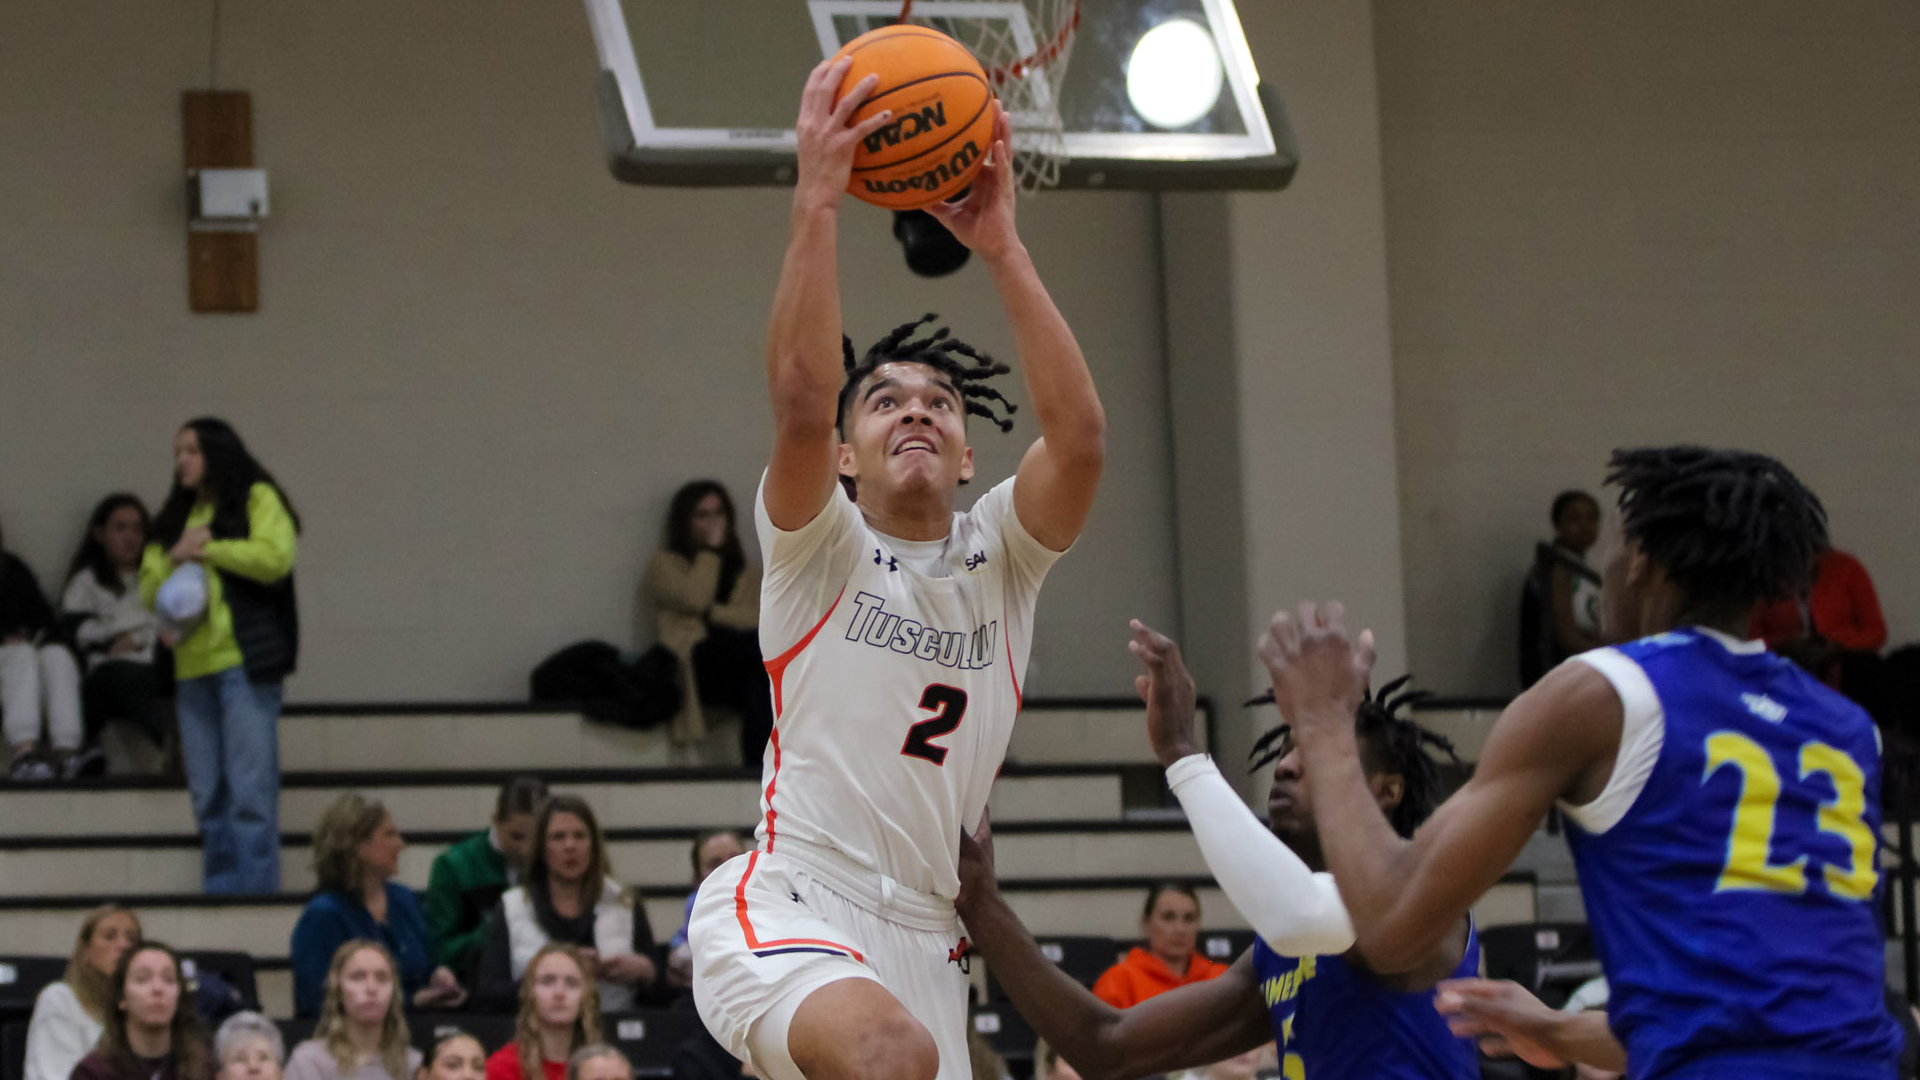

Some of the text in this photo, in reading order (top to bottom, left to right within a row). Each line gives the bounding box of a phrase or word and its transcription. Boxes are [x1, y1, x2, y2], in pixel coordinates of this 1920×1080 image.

[862, 101, 947, 153] NCAA
[900, 682, 968, 766] 2
[1701, 729, 1879, 902] 23
